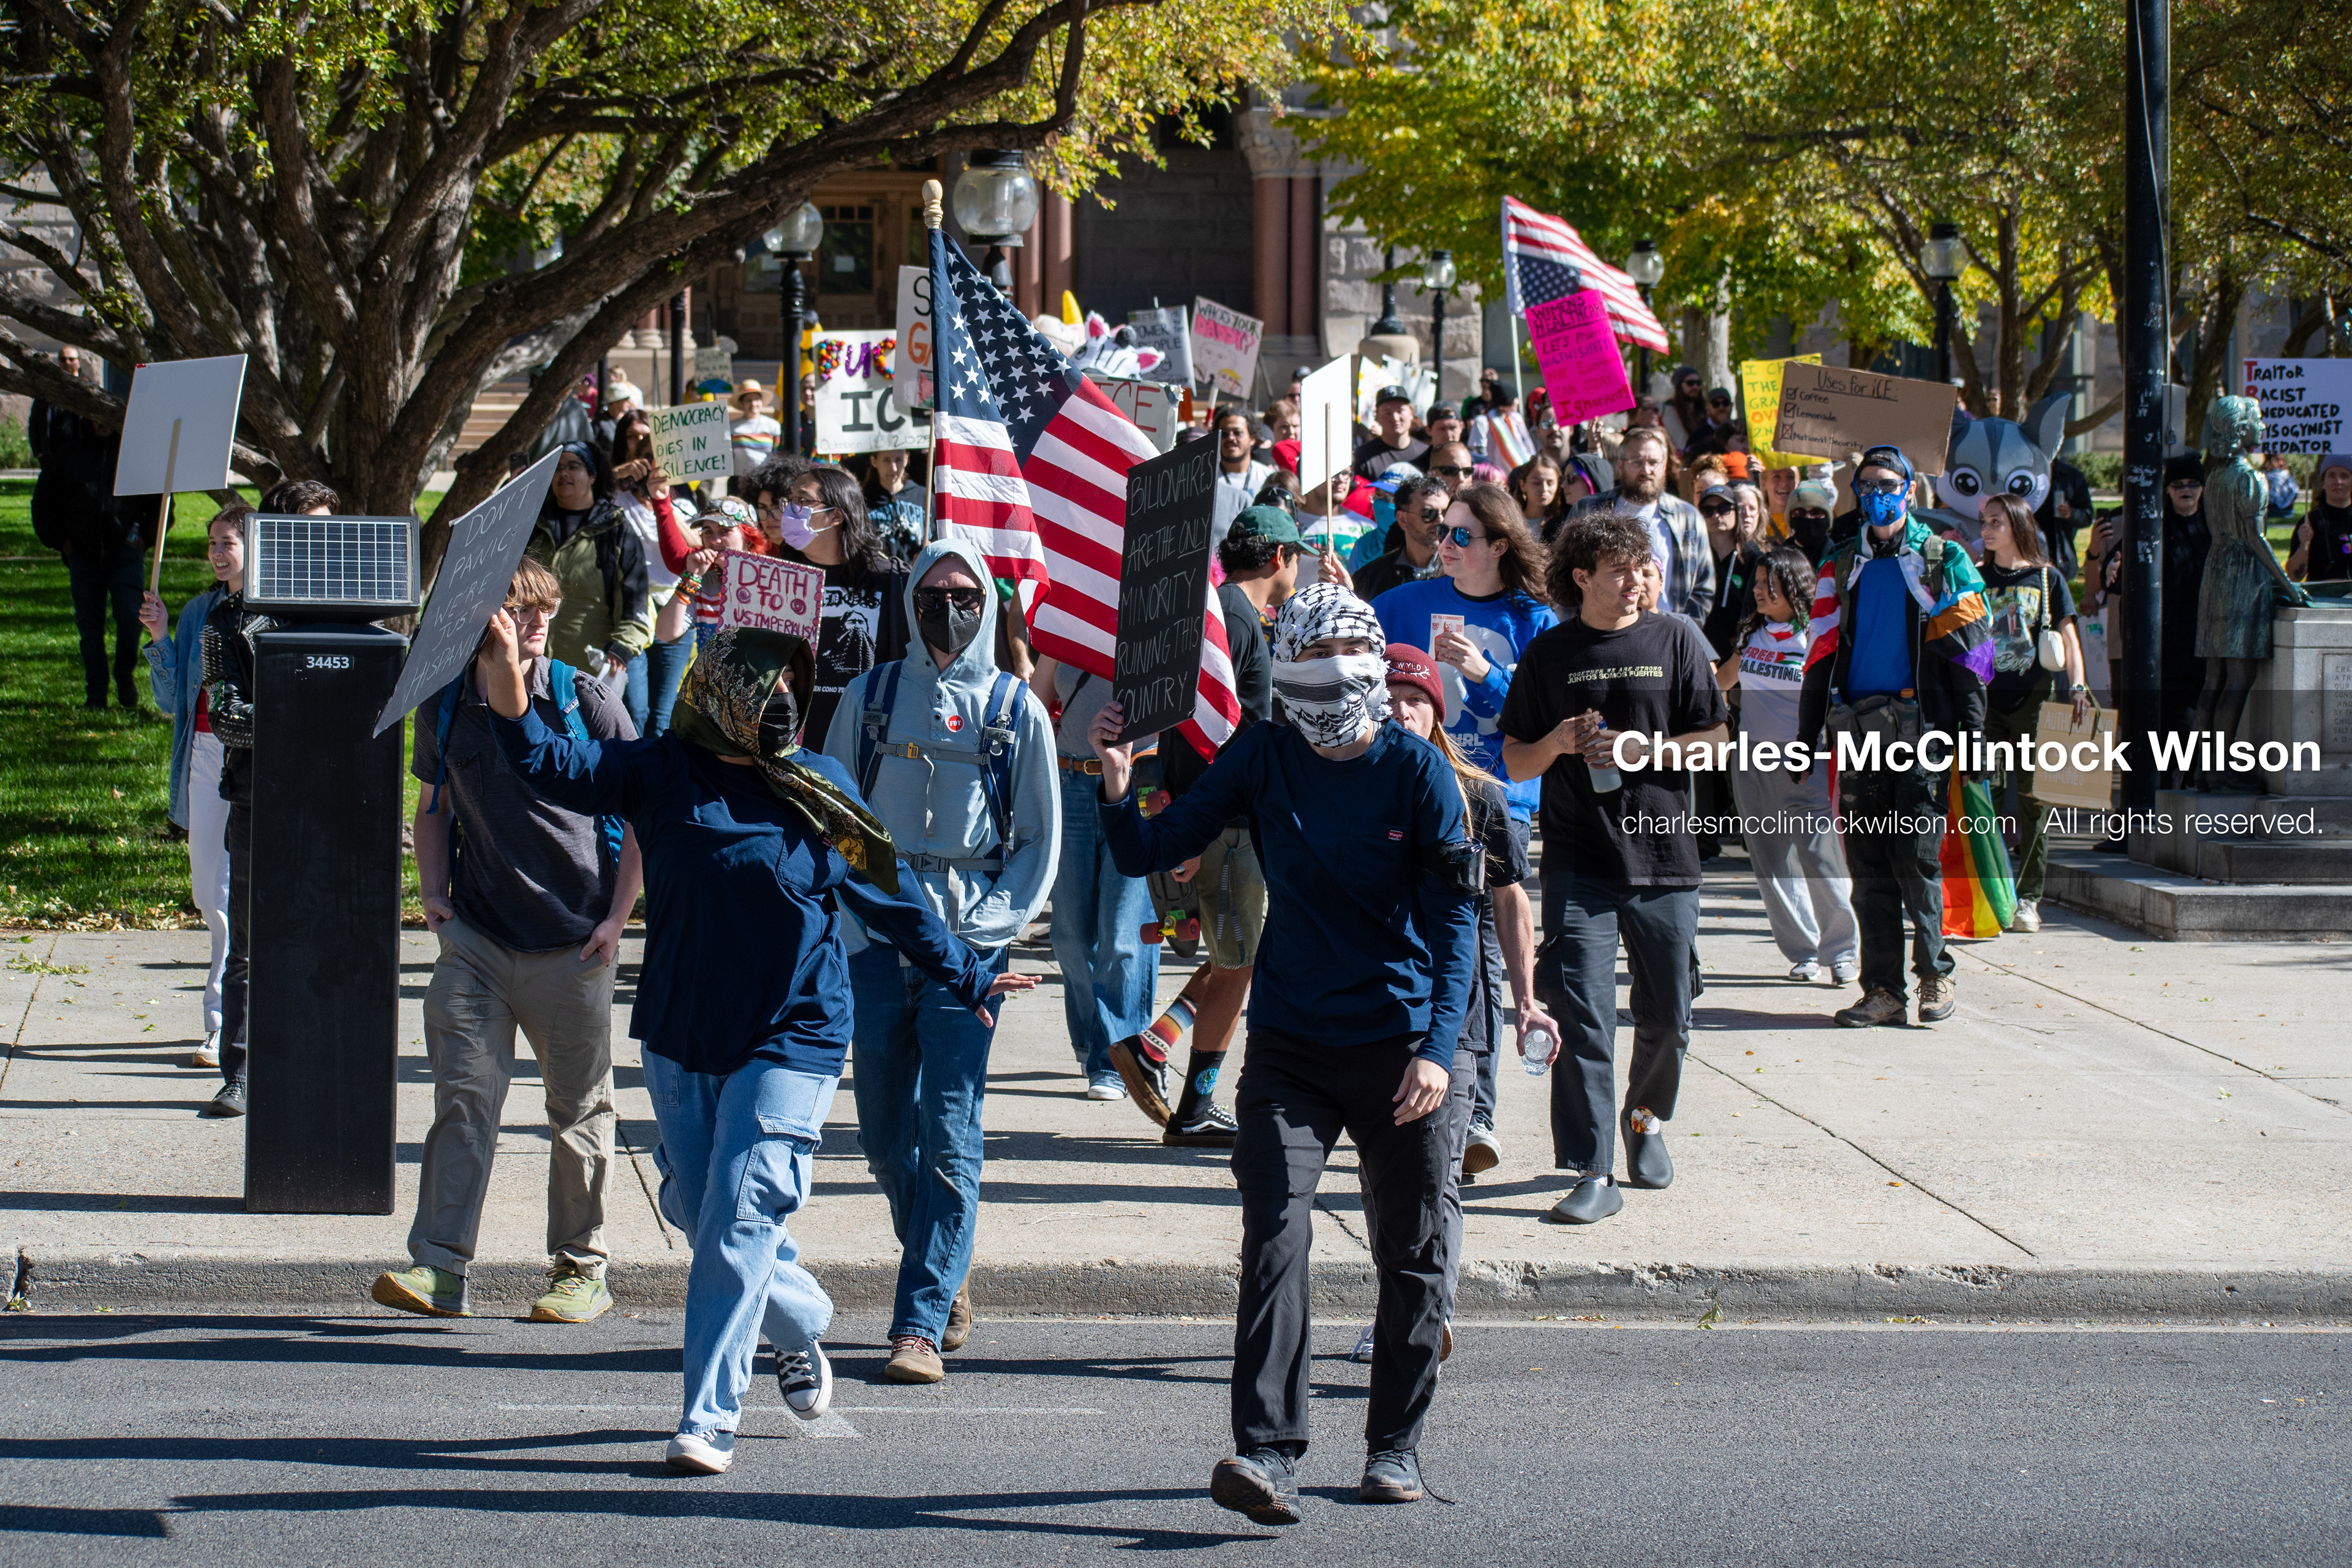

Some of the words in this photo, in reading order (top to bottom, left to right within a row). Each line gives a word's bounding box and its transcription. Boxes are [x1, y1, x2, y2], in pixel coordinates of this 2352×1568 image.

[1195, 314, 1256, 355] DADDY?
[1578, 338, 1609, 359] SAFETY
[1583, 373, 1612, 392] STAY
[1747, 380, 1779, 393] THE
[1817, 370, 1847, 392] Uses
[1850, 375, 1868, 394] for
[1799, 391, 1830, 404] Coffee
[2245, 385, 2307, 404] RACIST
[653, 404, 726, 435] DEMOCRACY
[2260, 403, 2340, 419] NEDUCATED
[656, 439, 684, 458] DIES
[693, 435, 707, 452] IN
[1792, 431, 1827, 444] National
[1829, 436, 1864, 452] Security
[2261, 439, 2332, 455] REDATOR
[662, 454, 726, 480] SILENCE!
[464, 478, 536, 548] DON'T
[1126, 533, 1155, 577] ARE
[1155, 525, 1176, 563] THE
[1178, 513, 1211, 555] ONLY
[738, 560, 809, 600] DEATH
[434, 571, 493, 628] WE'RE
[758, 590, 785, 612] TO
[1120, 567, 1197, 631] MINORITY
[432, 600, 484, 652] JUST
[1174, 616, 1200, 659] THIS
[306, 656, 350, 669] 34453
[404, 624, 488, 704] HISPANIC
[1743, 646, 1776, 663] FREE
[1398, 662, 1422, 671] WYLD
[1568, 668, 1604, 679] TOGETHER
[1567, 673, 1597, 684] JUNTOS
